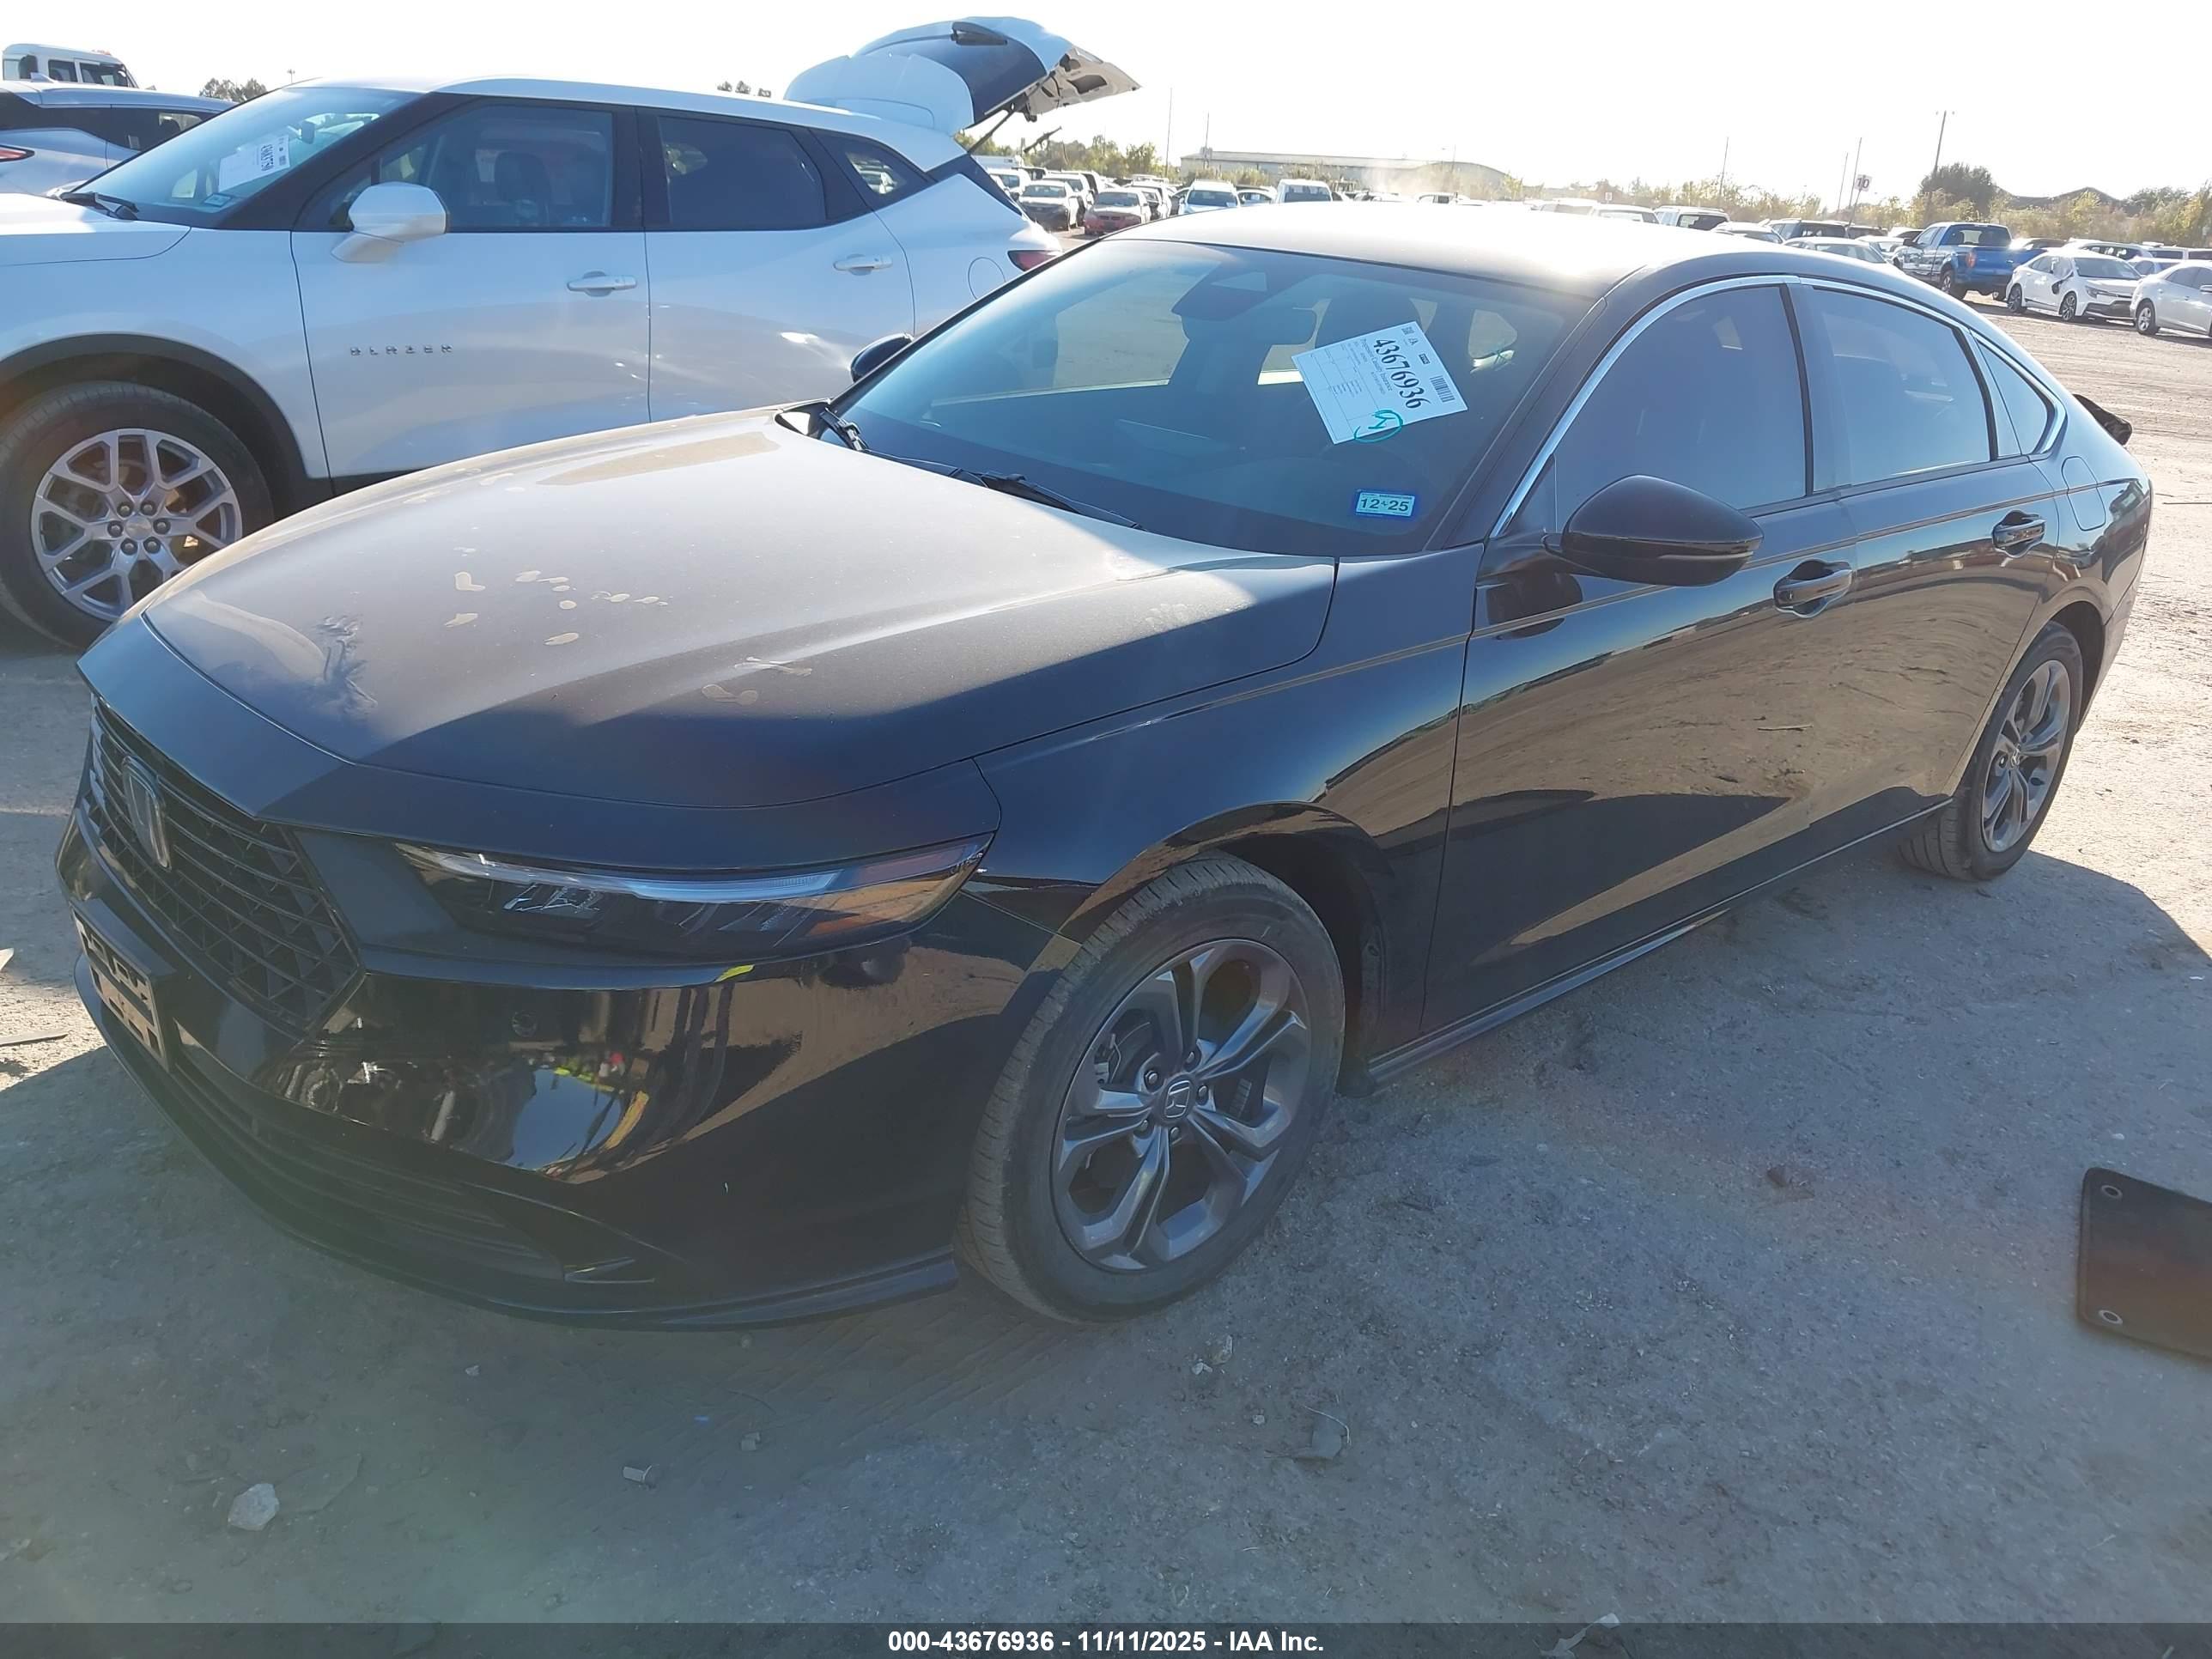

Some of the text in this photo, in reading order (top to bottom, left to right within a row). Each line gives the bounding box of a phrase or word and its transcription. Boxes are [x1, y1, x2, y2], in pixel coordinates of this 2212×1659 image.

[1856, 177, 1869, 188] 10
[350, 345, 453, 356] BLAZER
[1374, 340, 1431, 408] 43676936
[1361, 498, 1410, 512] 12 25
